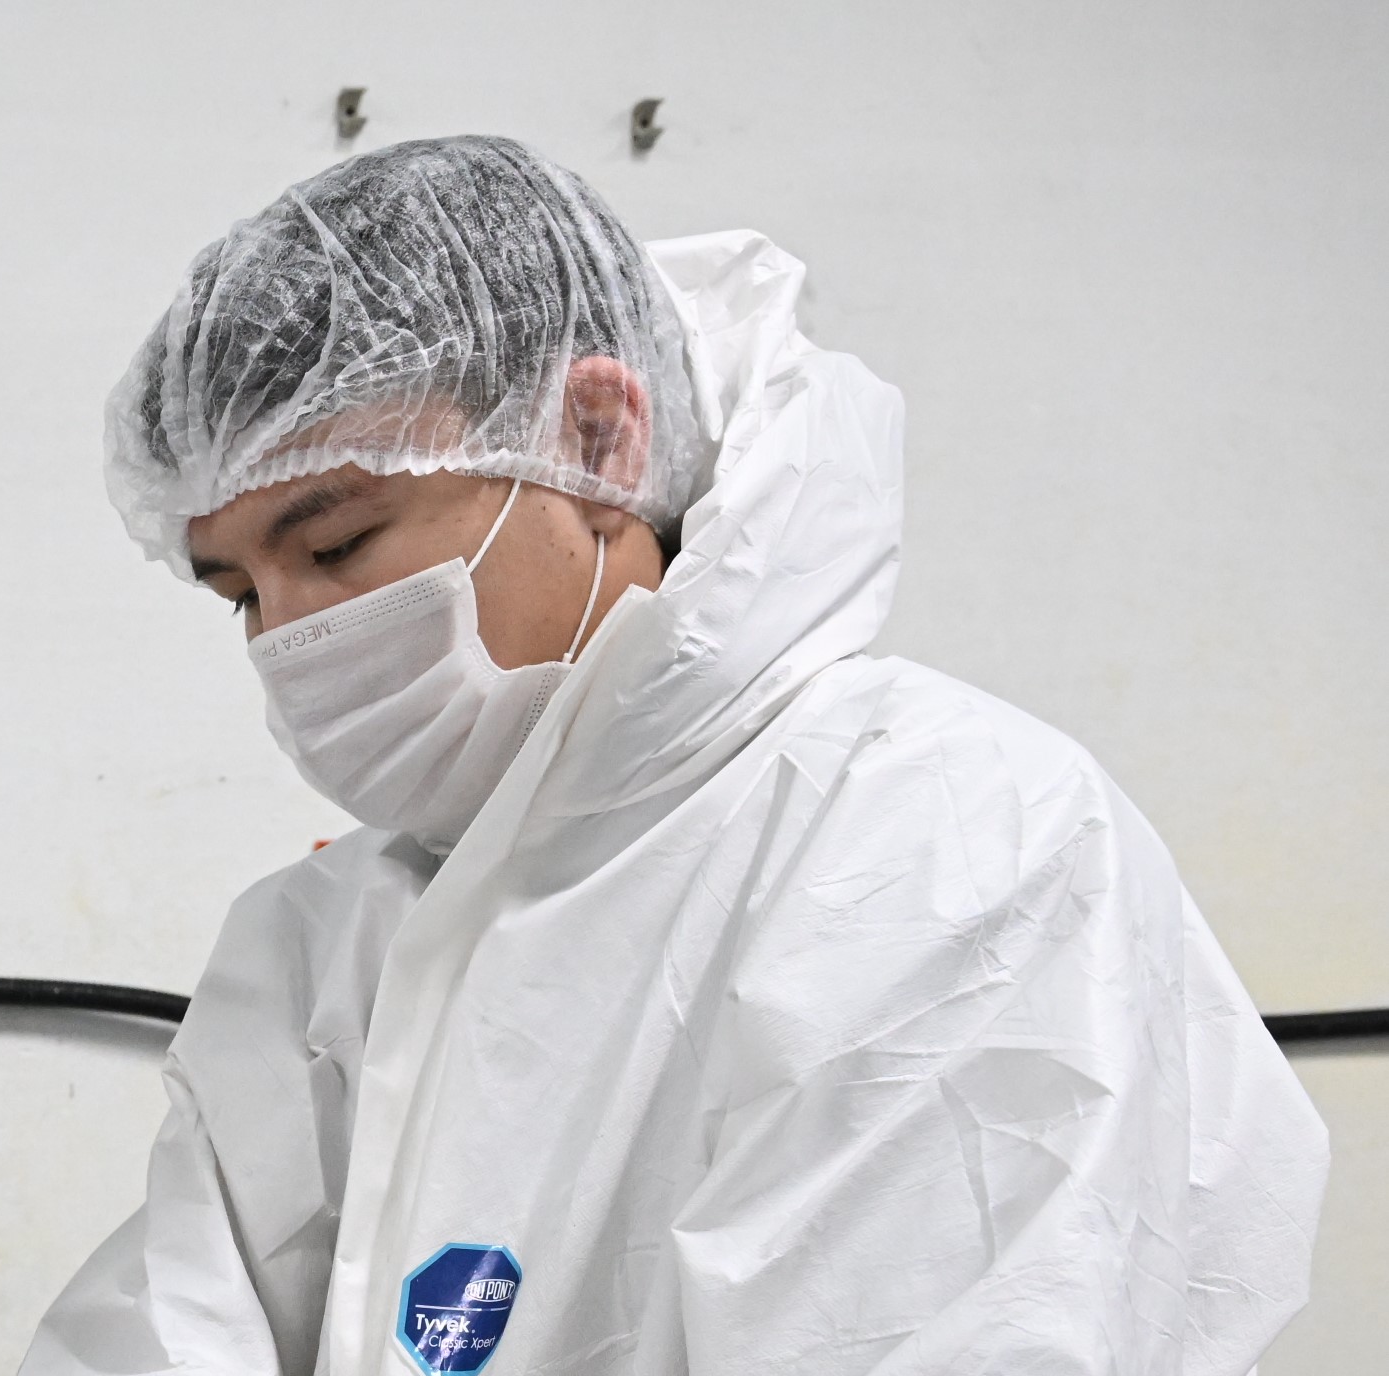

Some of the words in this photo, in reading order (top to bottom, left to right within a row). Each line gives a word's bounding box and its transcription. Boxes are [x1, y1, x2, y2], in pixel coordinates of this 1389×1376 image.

[281, 620, 332, 651] MEGA
[415, 1314, 471, 1334] Tyvek
[428, 1335, 468, 1349] Classic
[470, 1335, 496, 1350] Xpert
